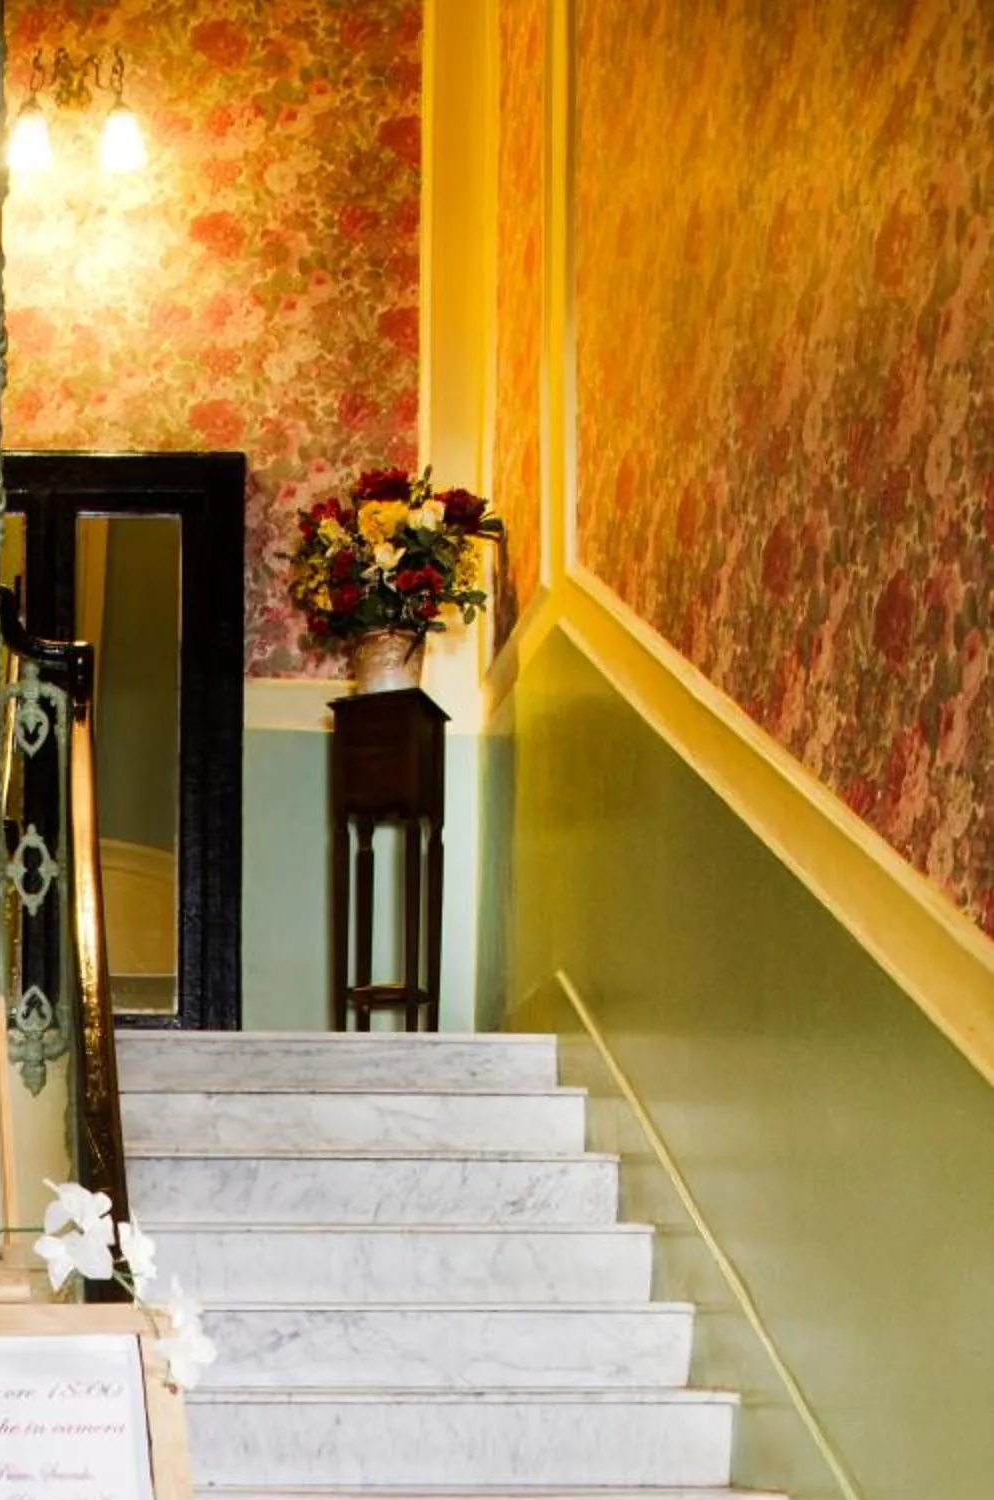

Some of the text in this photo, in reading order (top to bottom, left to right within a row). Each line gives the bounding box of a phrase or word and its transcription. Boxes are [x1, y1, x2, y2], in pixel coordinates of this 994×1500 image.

[3, 1388, 36, 1399] ore
[24, 1422, 45, 1435] in
[51, 1423, 126, 1436] camera
